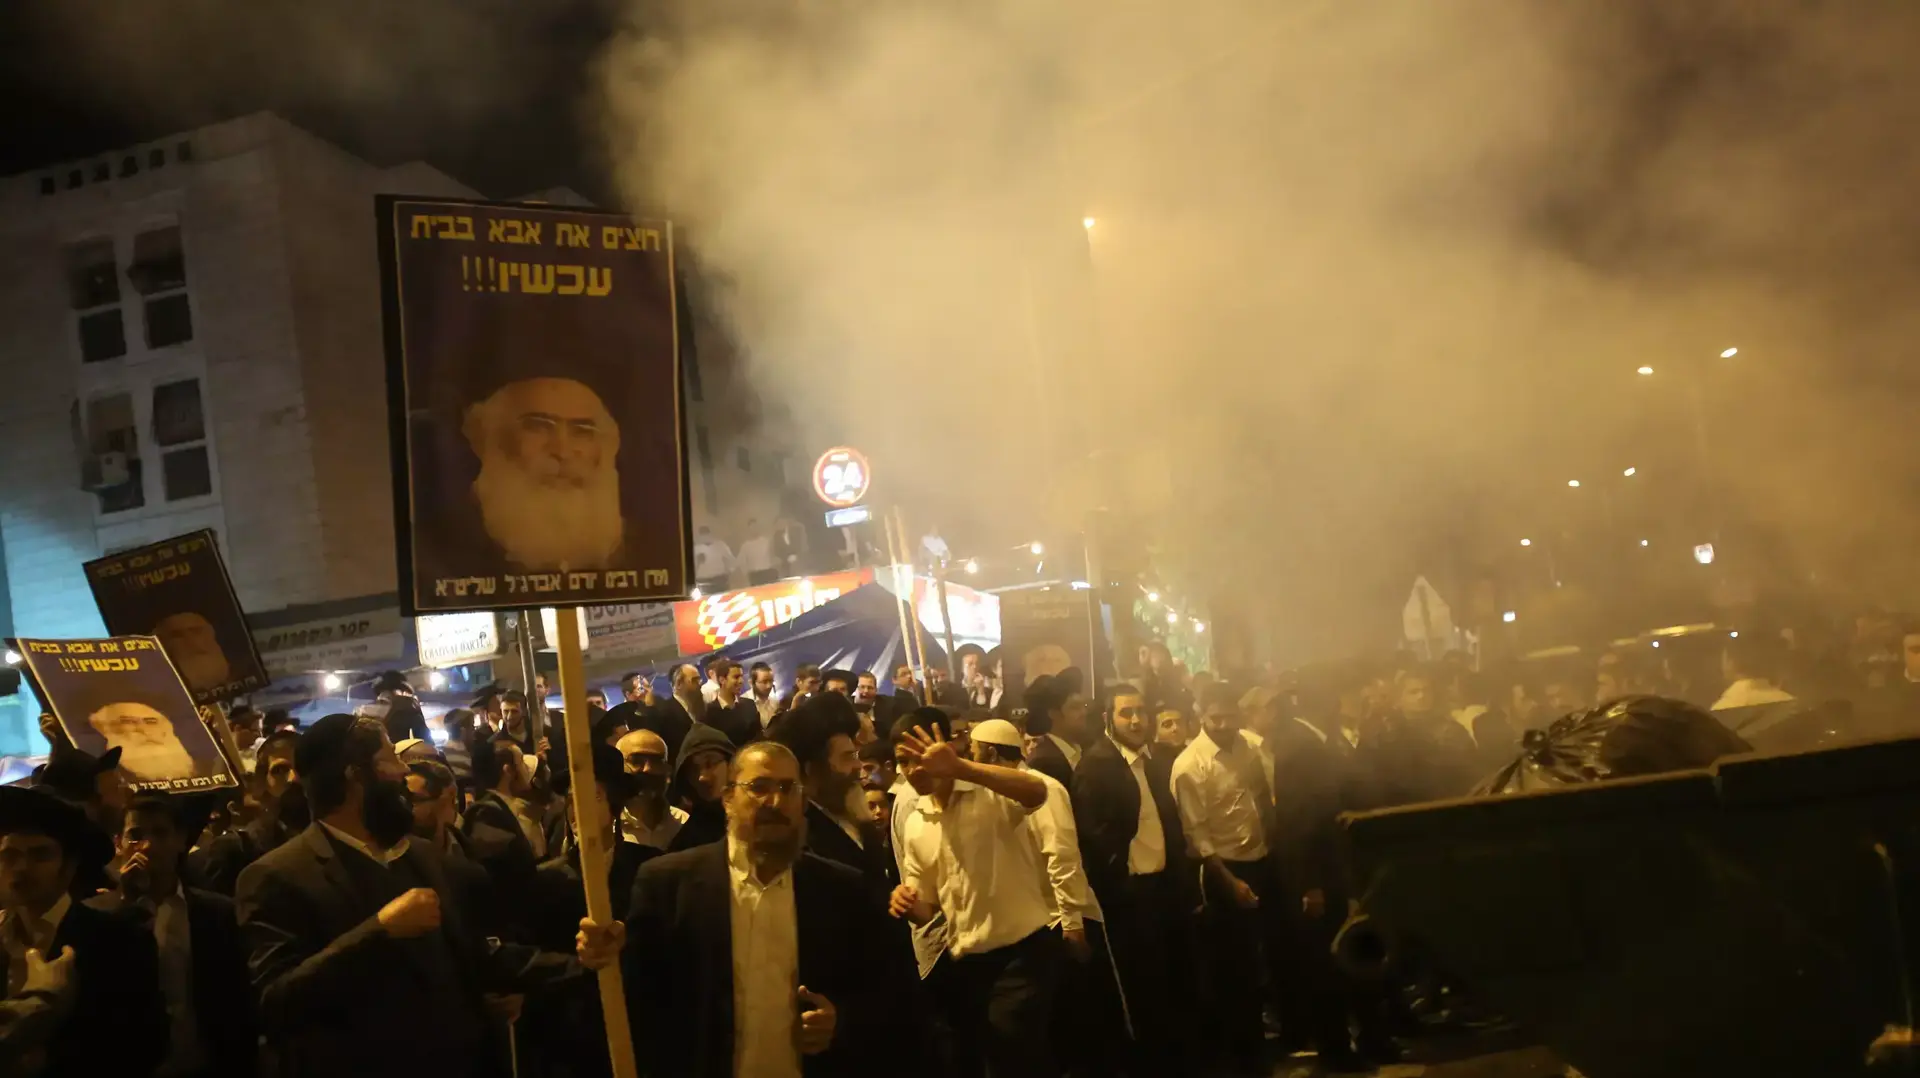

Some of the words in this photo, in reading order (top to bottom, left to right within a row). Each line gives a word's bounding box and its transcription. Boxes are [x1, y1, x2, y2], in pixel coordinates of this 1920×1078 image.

[411, 215, 475, 241] בבית
[488, 219, 541, 245] אבא
[556, 223, 590, 248] את
[602, 226, 660, 251] רוצים
[462, 255, 612, 296] עכשיו!!!
[643, 569, 669, 589] מרן
[28, 642, 62, 653] בבית
[65, 643, 96, 653] אבא
[100, 643, 120, 653] את
[123, 640, 156, 651] רוצים
[59, 657, 139, 672] עכשיו!!!
